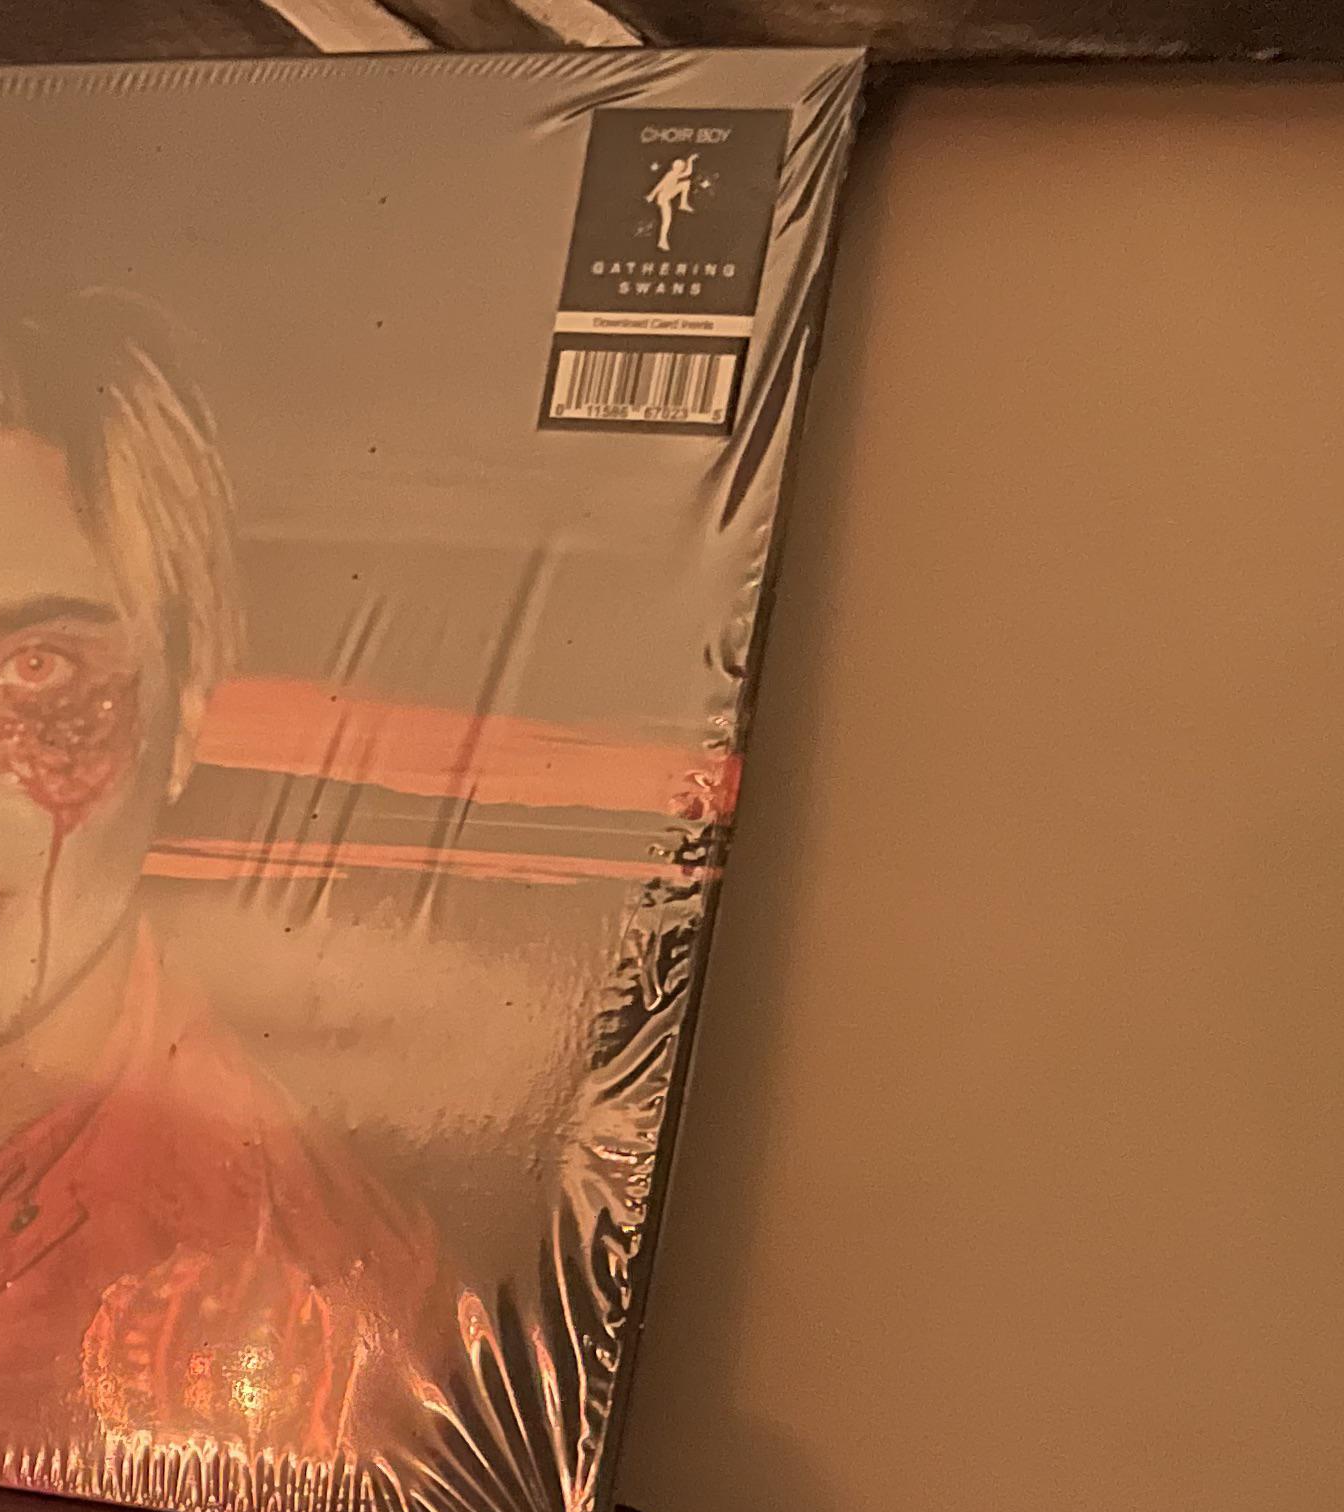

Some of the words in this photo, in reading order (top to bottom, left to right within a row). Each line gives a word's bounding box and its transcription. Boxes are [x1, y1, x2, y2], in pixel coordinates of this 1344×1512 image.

[640, 126, 694, 143] CHOIR
[695, 127, 731, 143] BOY
[591, 261, 736, 278] GATHERING
[618, 281, 702, 296] SWANS
